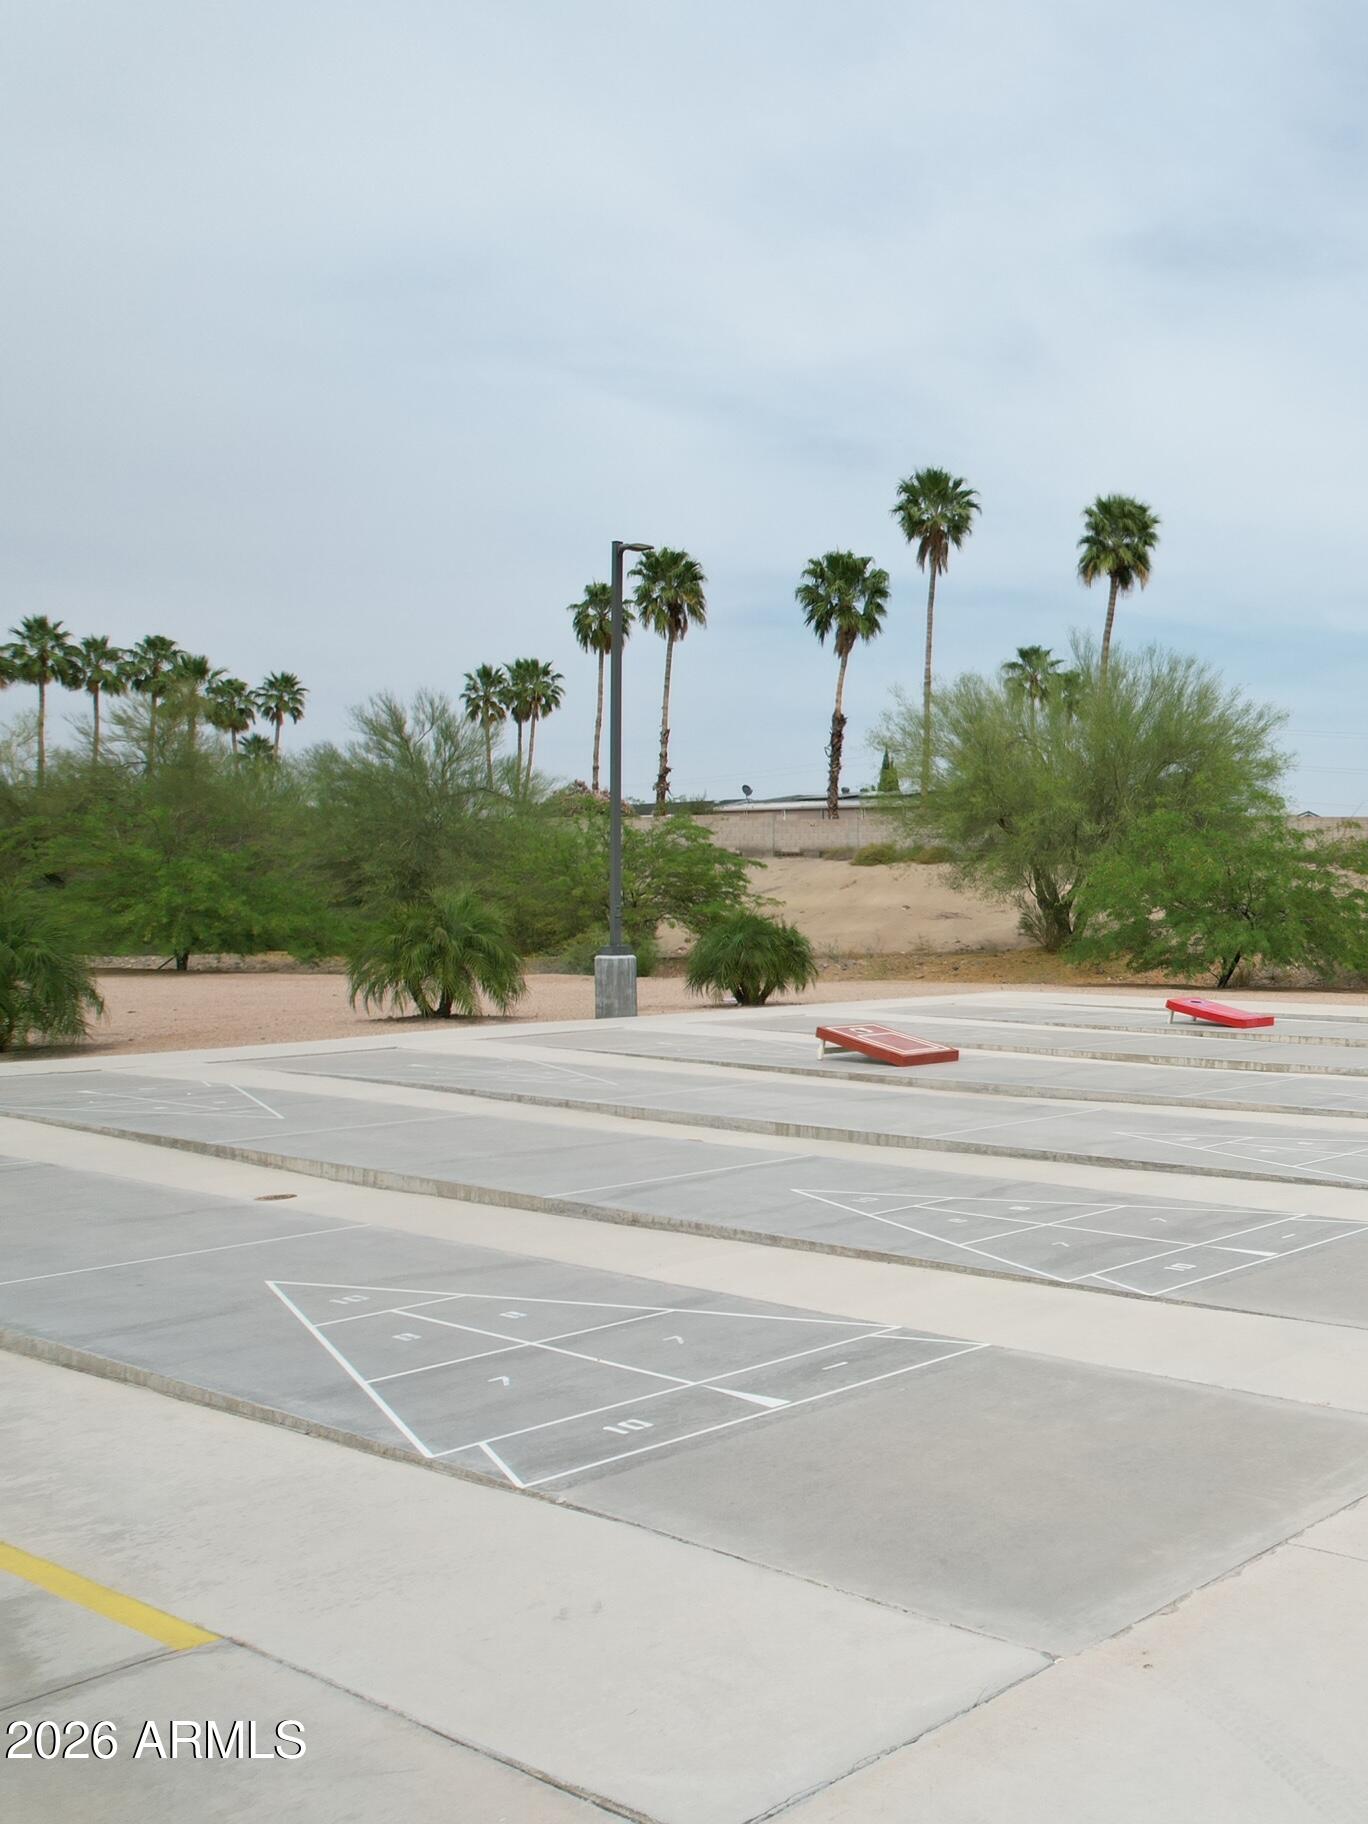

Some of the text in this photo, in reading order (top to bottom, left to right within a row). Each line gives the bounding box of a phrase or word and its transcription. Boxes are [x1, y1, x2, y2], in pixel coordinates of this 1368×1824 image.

[1163, 1262, 1197, 1272] 10
[328, 1294, 370, 1305] 10
[662, 1335, 685, 1345] 7
[487, 1375, 511, 1387] 7
[602, 1418, 655, 1435] 10
